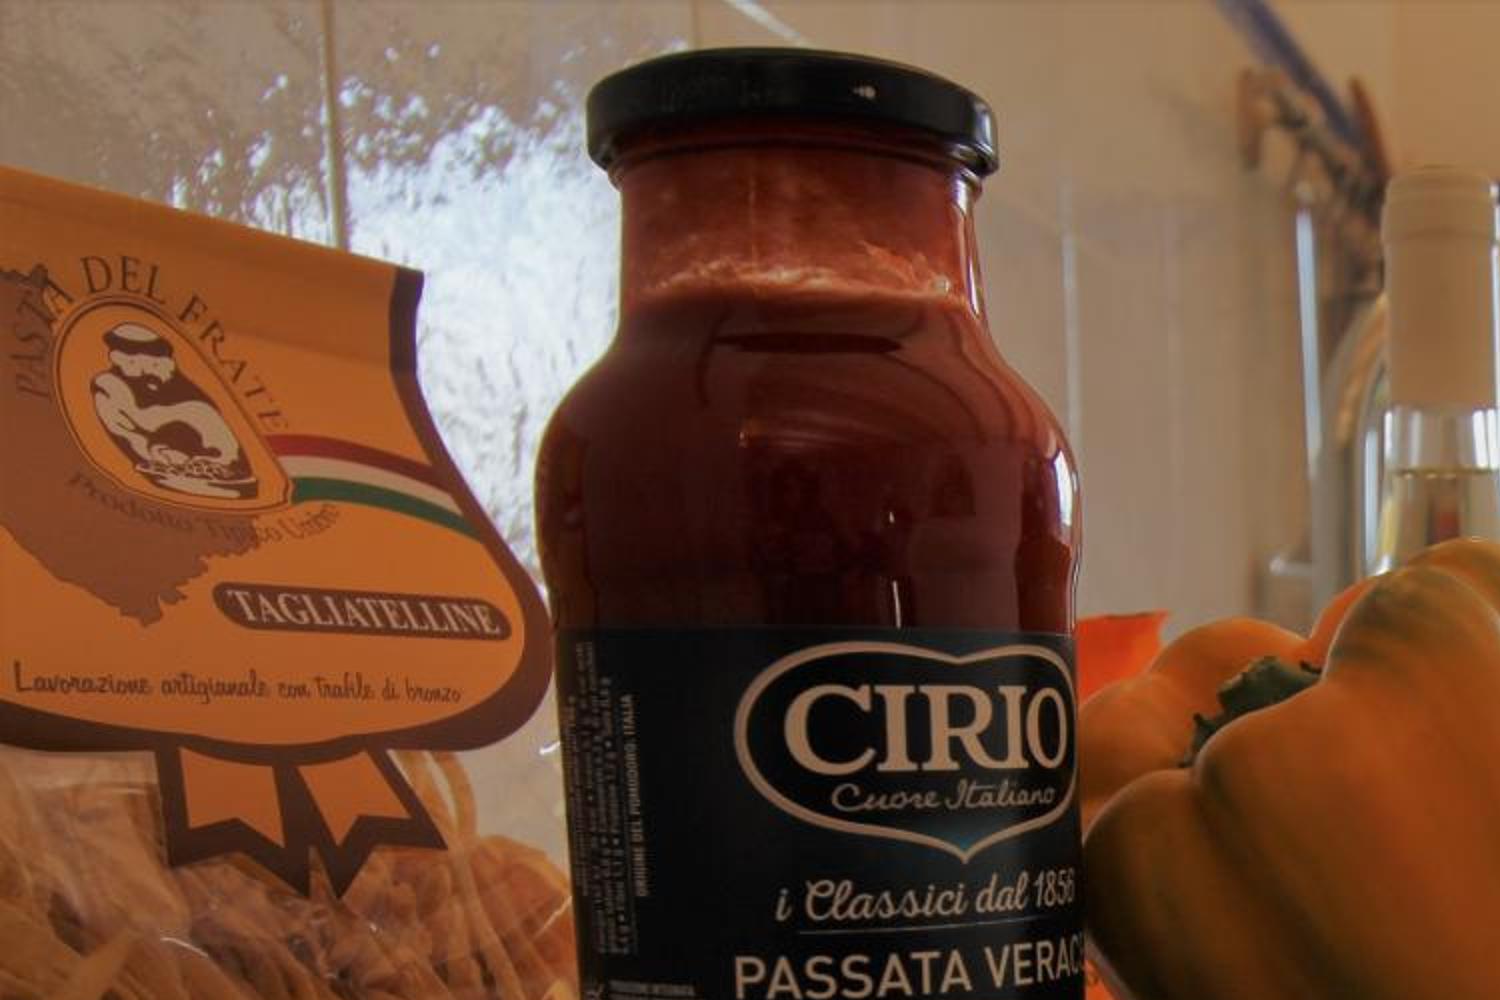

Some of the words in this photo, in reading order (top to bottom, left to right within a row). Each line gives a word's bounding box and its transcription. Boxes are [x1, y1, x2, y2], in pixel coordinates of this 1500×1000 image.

[79, 255, 166, 304] DEL
[177, 294, 290, 434] FRATE
[226, 588, 500, 635] TAGLIATELLINE
[13, 660, 151, 694] Lavorazione
[161, 669, 267, 704] artigianale
[277, 680, 309, 698] con
[382, 677, 400, 701] di
[405, 679, 462, 703] bronzo
[784, 683, 1069, 775] CIRIO
[831, 781, 942, 813] Cuore
[944, 777, 1058, 811] Italiano
[775, 887, 790, 922] i
[803, 879, 965, 922] Classici
[976, 871, 1029, 914] dal
[1034, 866, 1077, 909] 1856
[735, 947, 972, 1000] PASSATA
[983, 933, 1084, 990] VERAC
